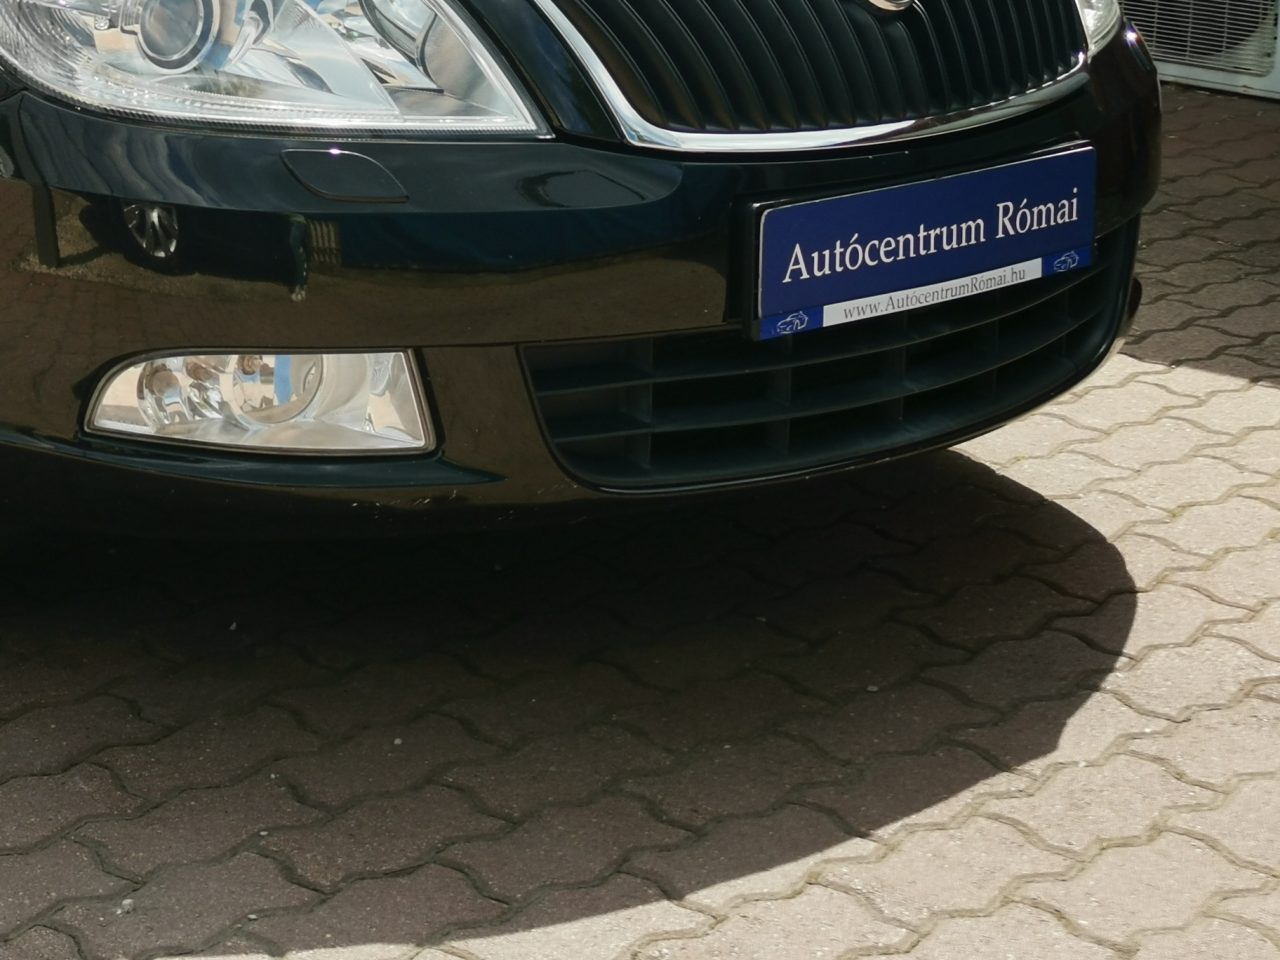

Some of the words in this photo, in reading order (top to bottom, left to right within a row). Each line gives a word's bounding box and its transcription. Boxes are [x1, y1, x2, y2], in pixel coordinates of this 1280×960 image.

[781, 218, 985, 283] Autócentrum
[995, 187, 1078, 239] Római
[843, 267, 1026, 320] www.AutócentrumRómai.hu
